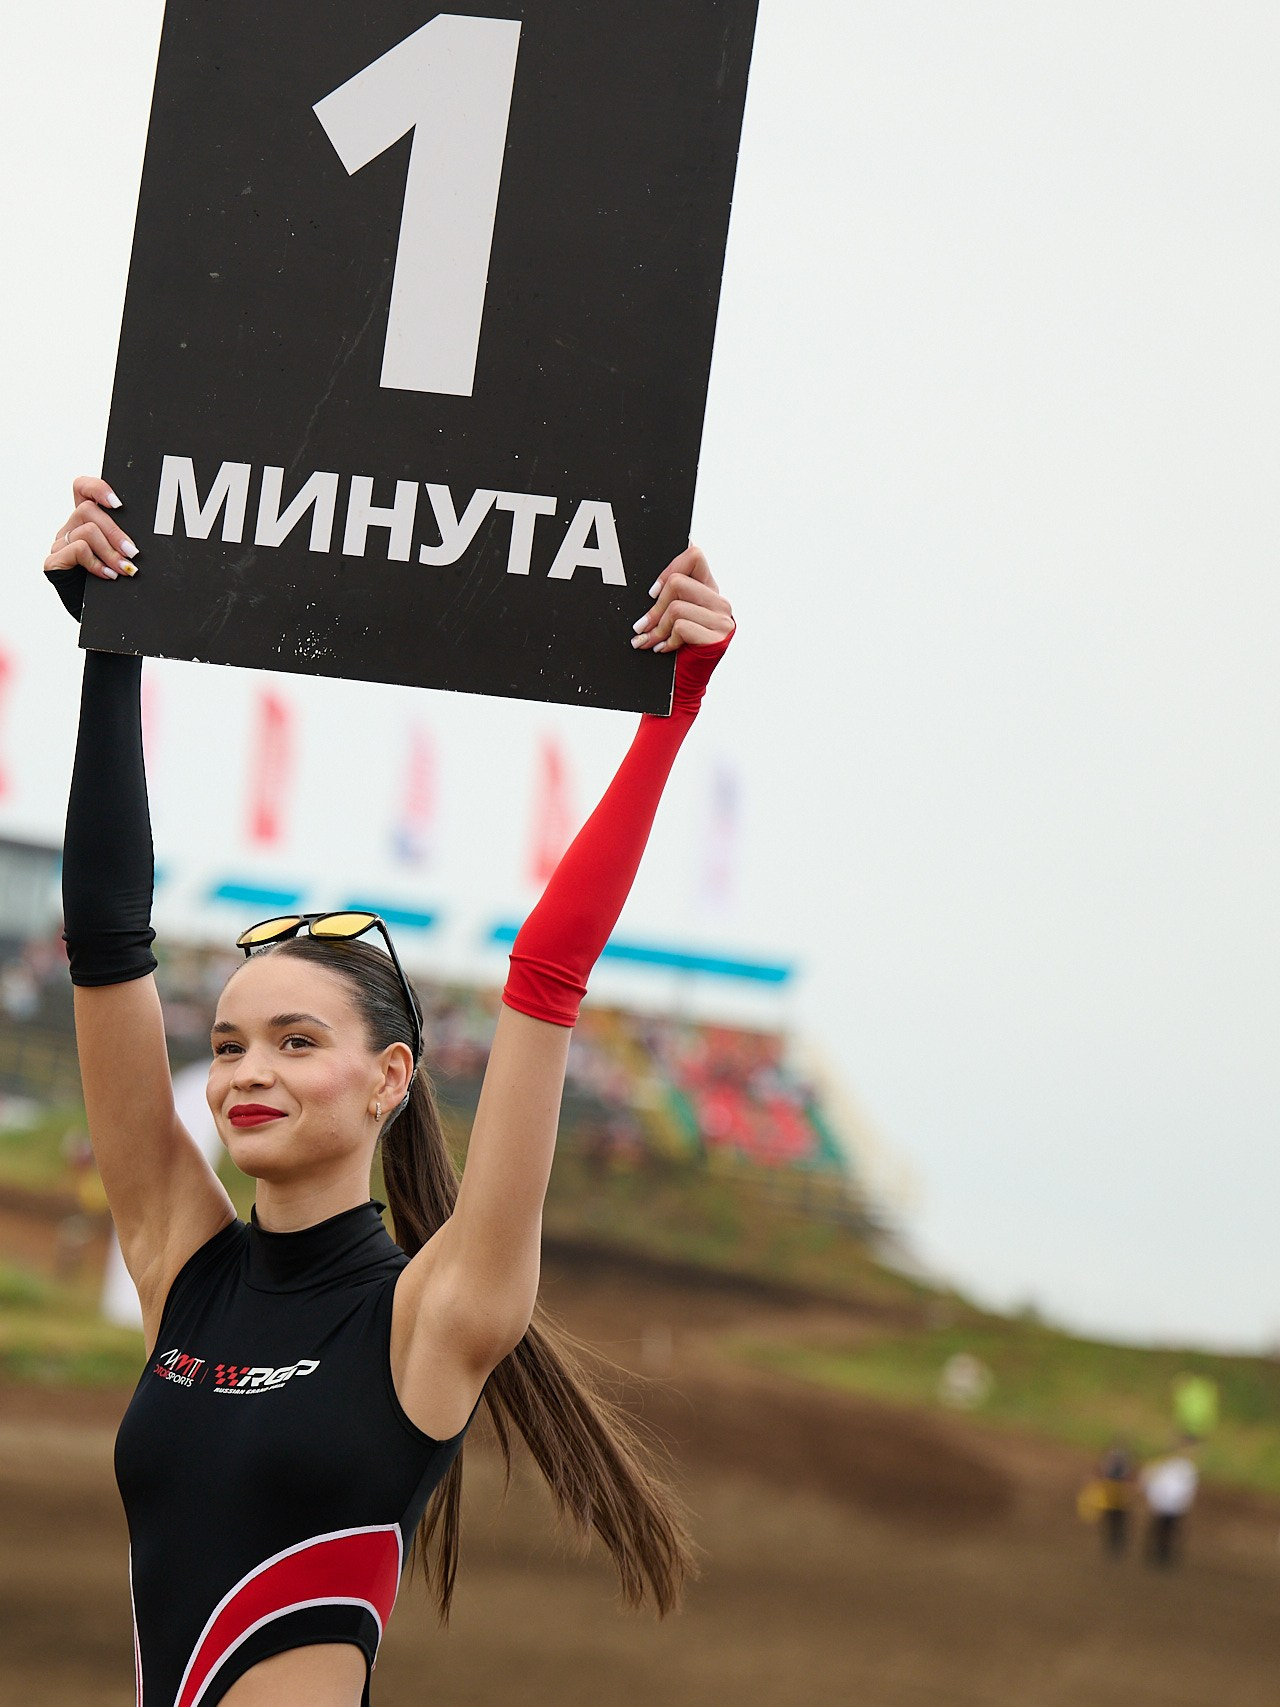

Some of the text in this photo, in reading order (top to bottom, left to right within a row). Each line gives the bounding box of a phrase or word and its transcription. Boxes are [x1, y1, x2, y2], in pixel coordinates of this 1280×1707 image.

[312, 13, 522, 397] 1
[153, 455, 628, 587] МИНУТА
[213, 1387, 246, 1395] RUSSIAN
[236, 1359, 321, 1387] RGP
